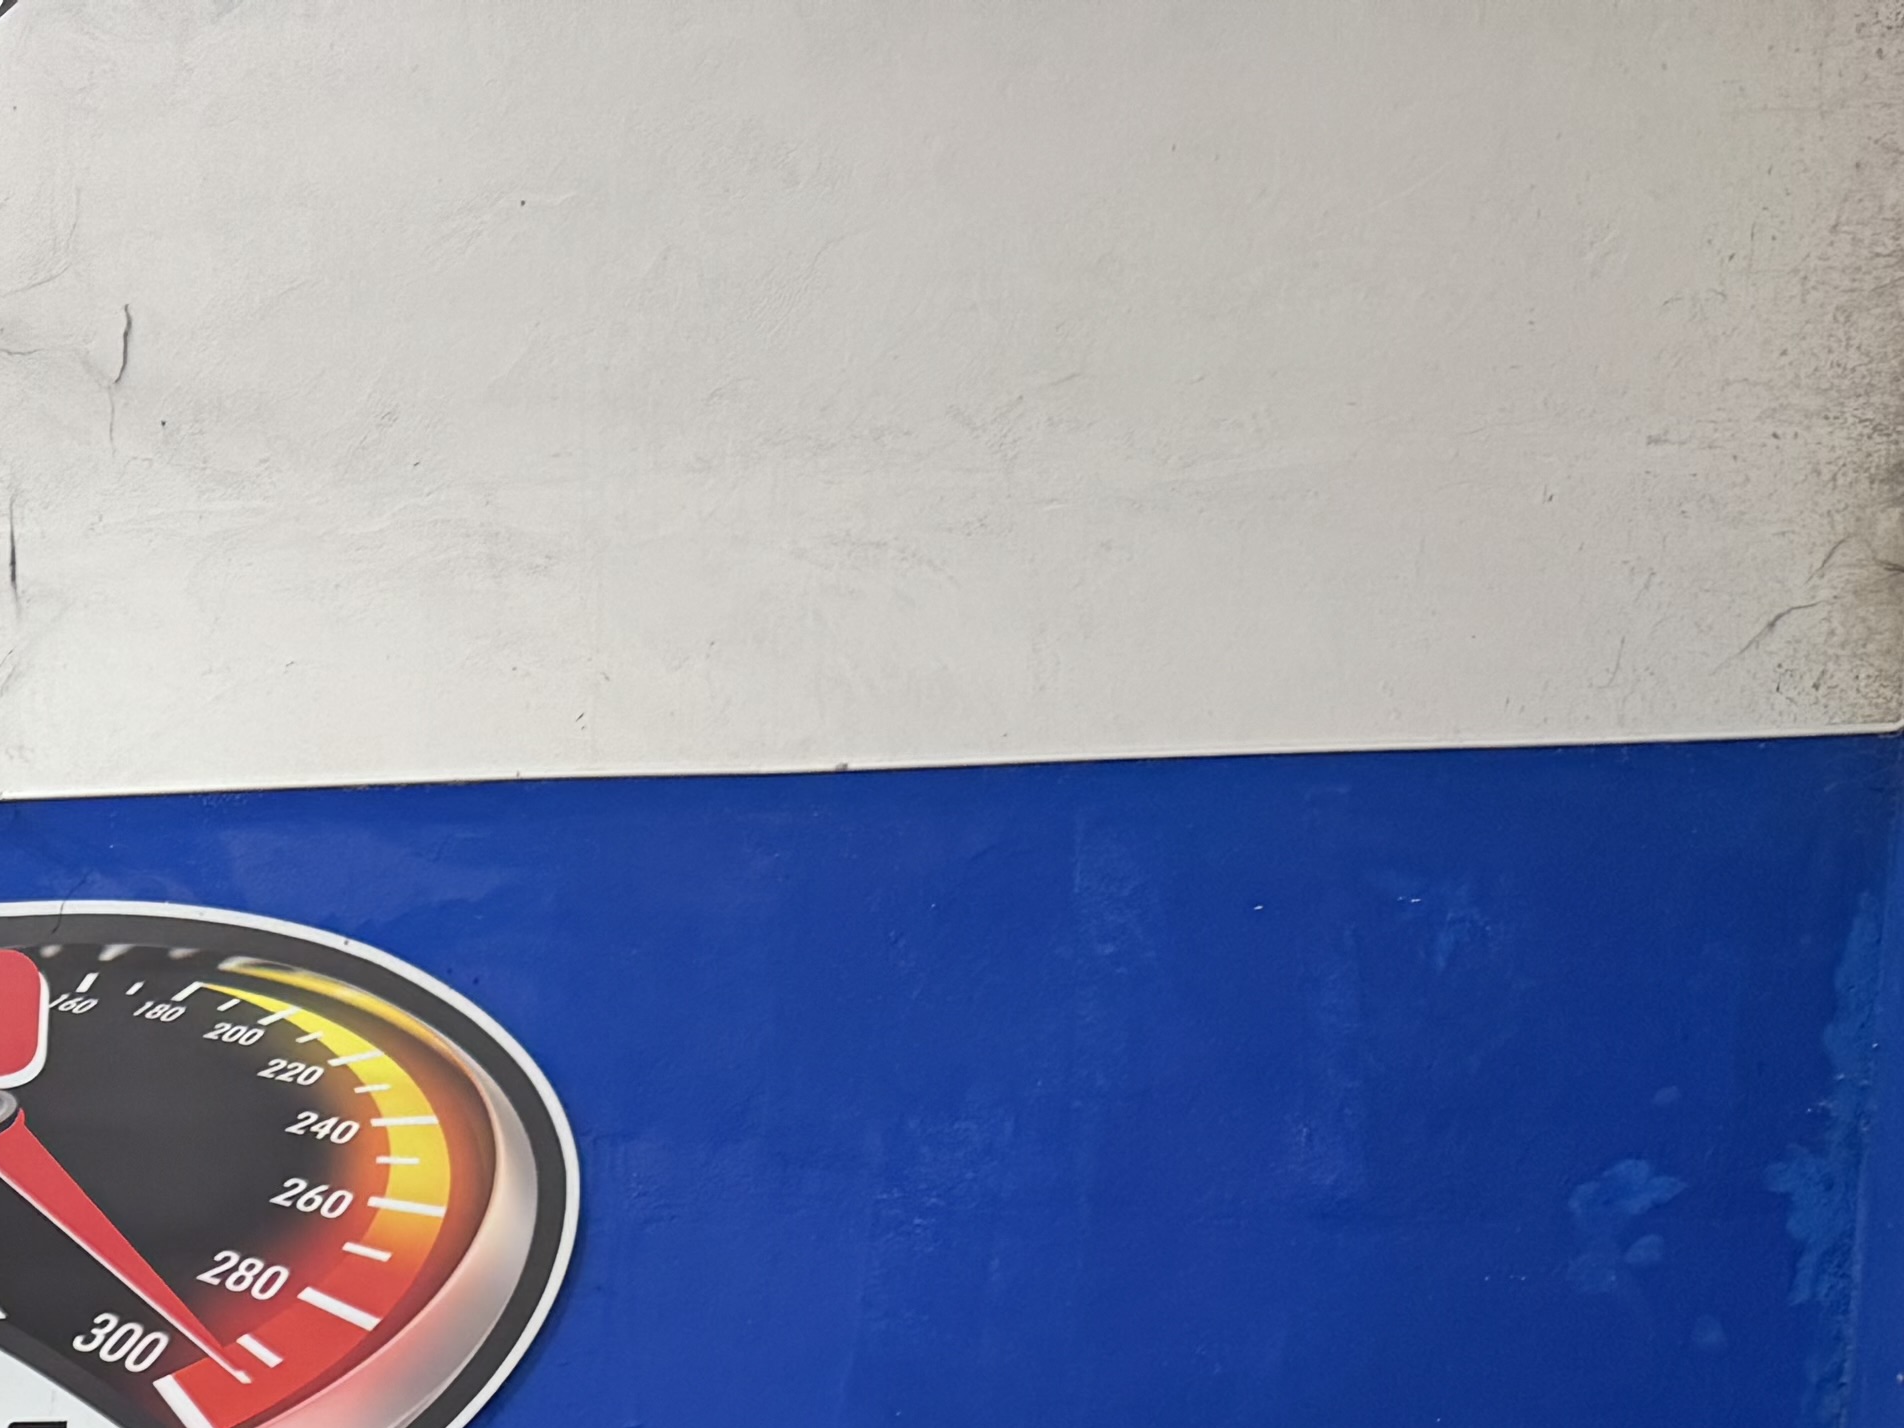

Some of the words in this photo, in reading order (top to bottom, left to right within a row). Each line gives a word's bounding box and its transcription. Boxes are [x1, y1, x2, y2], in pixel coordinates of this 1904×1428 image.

[49, 993, 98, 1014] 160
[134, 1001, 186, 1022] 180
[203, 1022, 265, 1046] 200
[257, 1059, 324, 1086] 220
[286, 1111, 359, 1145] 240
[269, 1178, 353, 1219] 260
[196, 1250, 289, 1300] 280
[72, 1313, 169, 1373] 300
